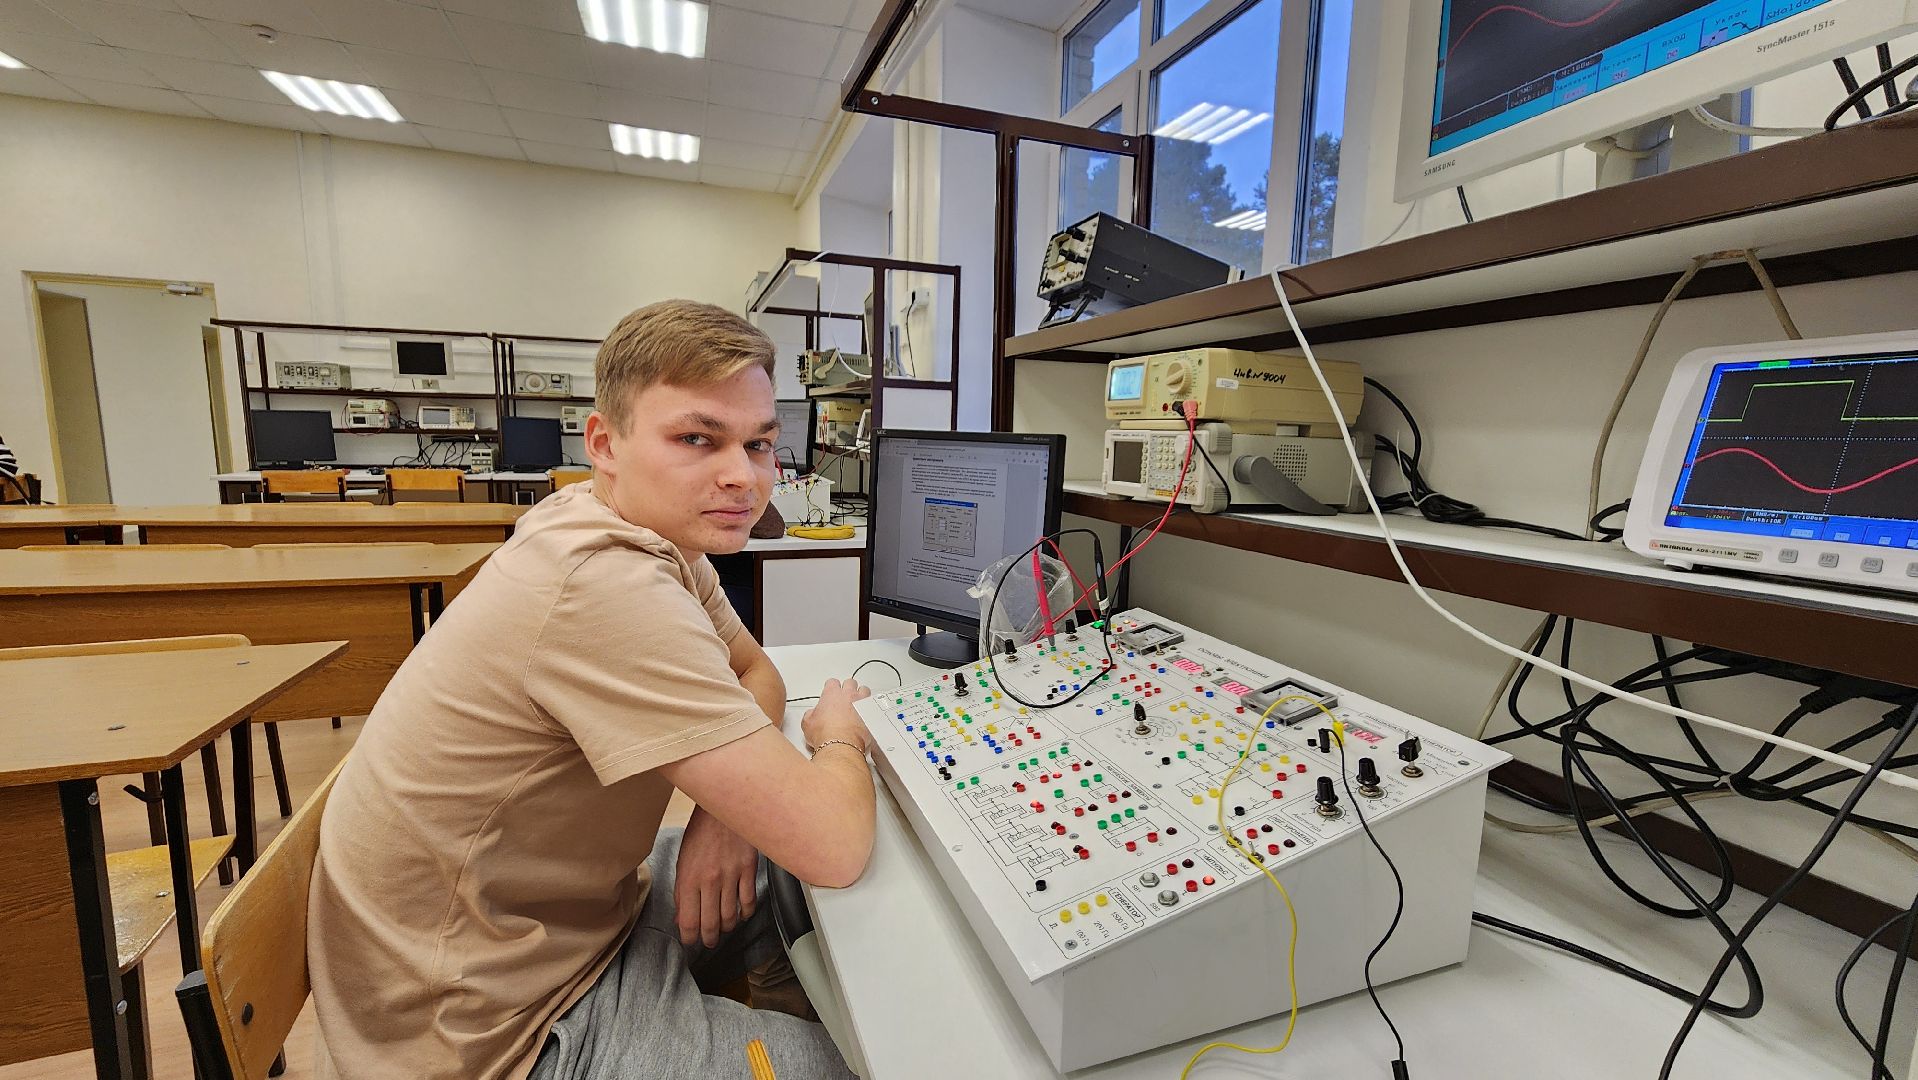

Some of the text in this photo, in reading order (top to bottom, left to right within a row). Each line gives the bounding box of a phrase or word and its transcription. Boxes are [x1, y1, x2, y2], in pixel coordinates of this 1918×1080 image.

[1757, 18, 1836, 53] SyncMaster 151s
[1424, 160, 1456, 177] SAMSUNG
[1113, 891, 1141, 918] ГЕНЕРАТОР
